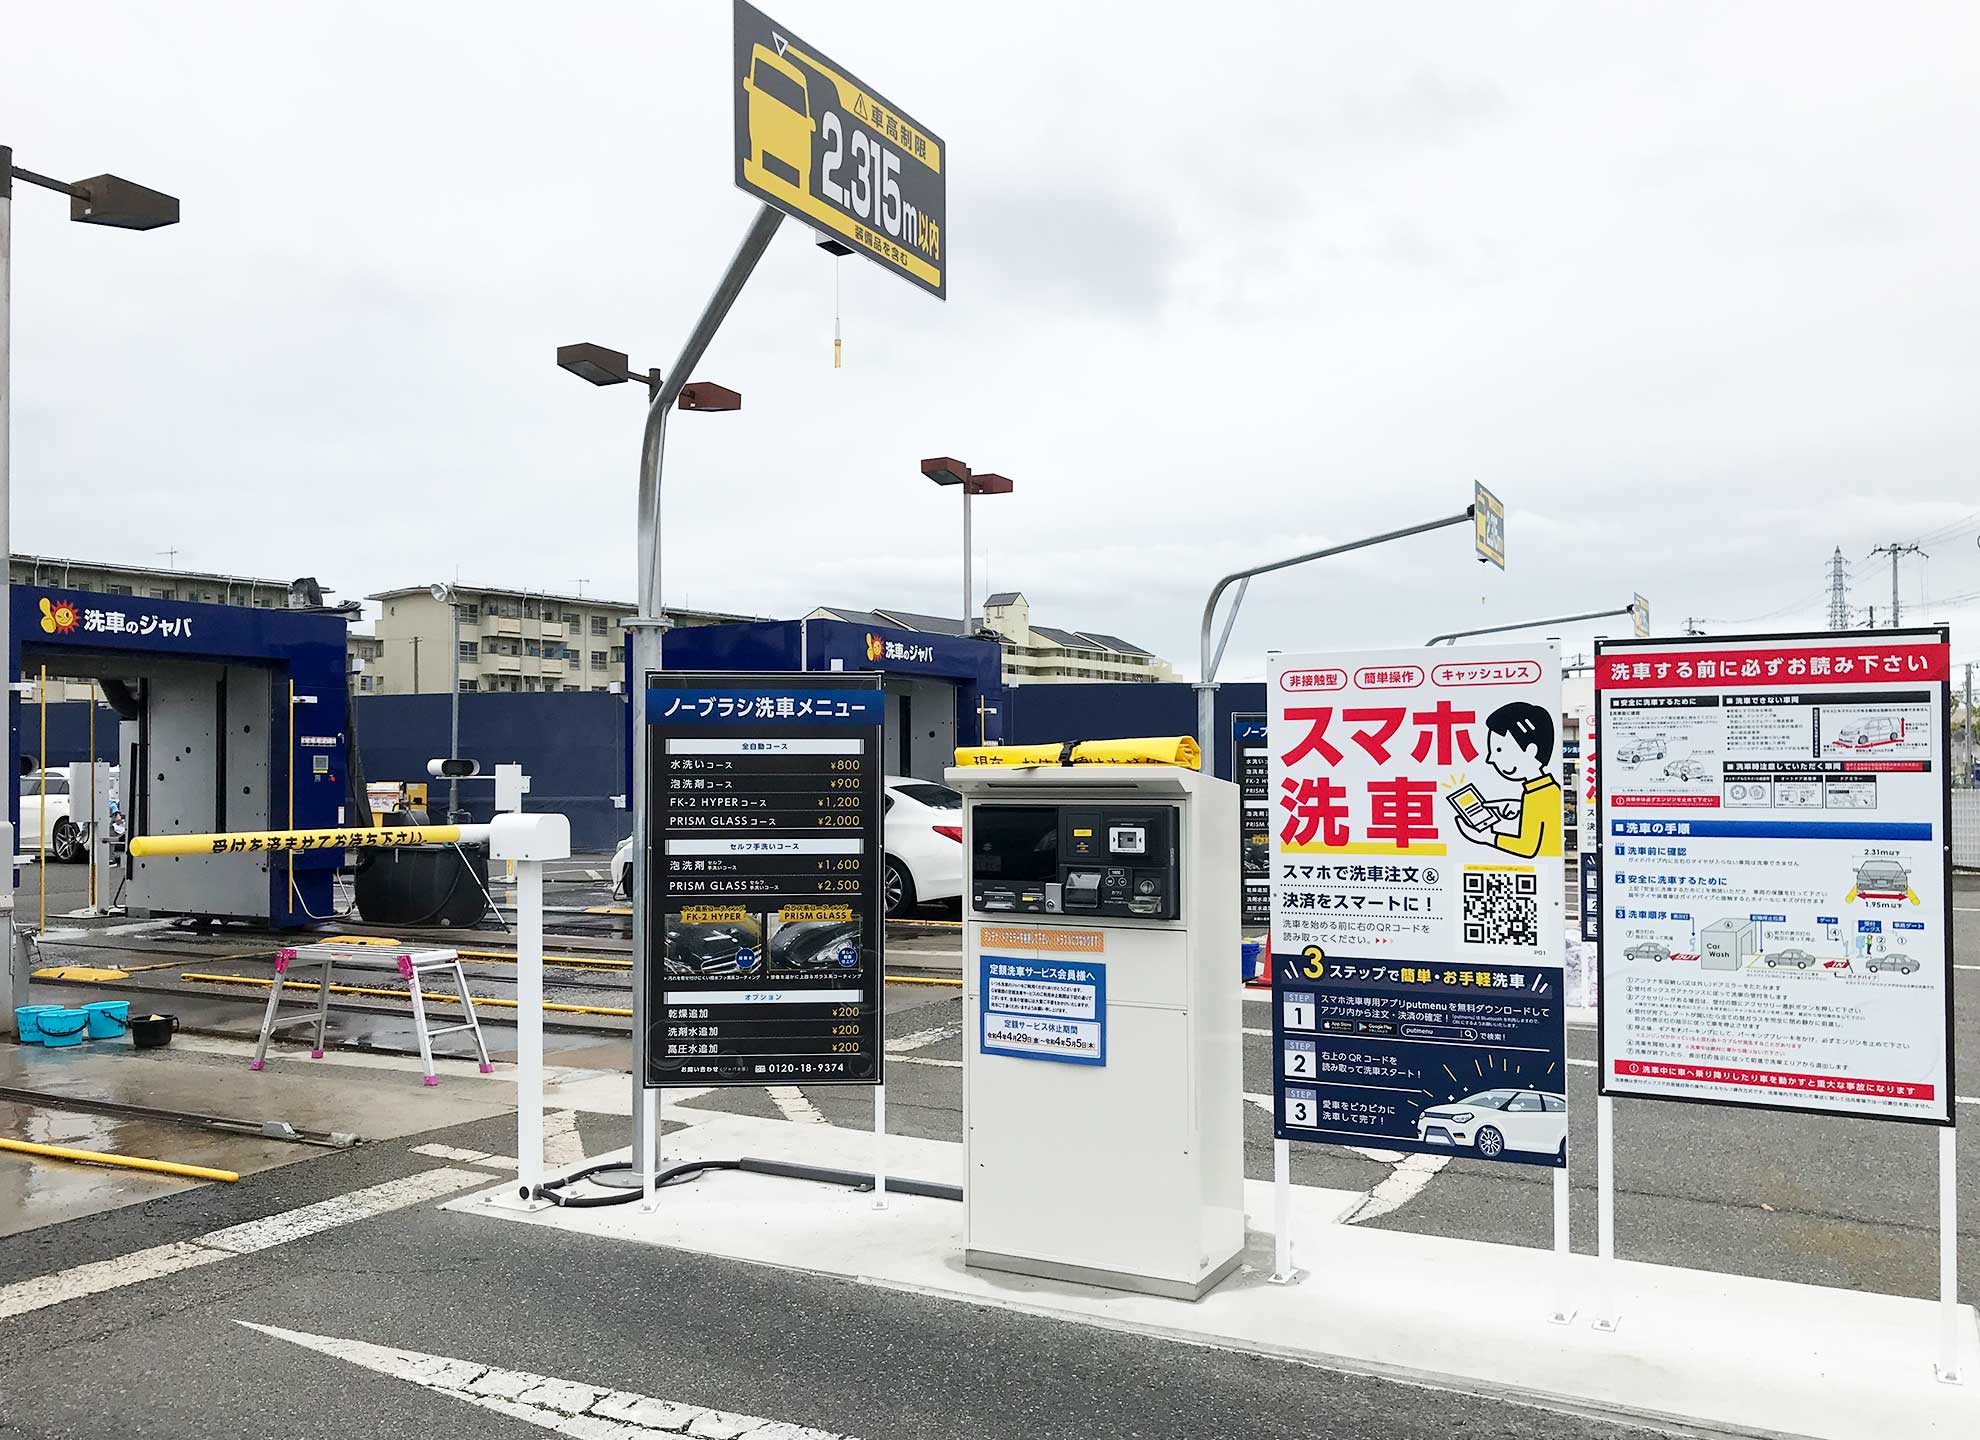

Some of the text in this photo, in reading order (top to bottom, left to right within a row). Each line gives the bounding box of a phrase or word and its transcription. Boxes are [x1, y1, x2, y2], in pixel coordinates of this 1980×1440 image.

[870, 105, 927, 159] 車高制限
[822, 111, 940, 261] 2.315m以内
[854, 225, 908, 266] 装備品を含む
[84, 609, 192, 639] 洗車のジャバ
[886, 641, 933, 662] 洗車のジャバ
[1611, 654, 1928, 681] 洗車する前に必ずお読み下さい
[1290, 666, 1530, 686] 非接触型 簡単操作 キャッシュレス
[664, 697, 866, 718] ノーブラシ洗車メニュー
[1280, 701, 1479, 767] スマホ
[742, 742, 788, 750] 全自動コース
[670, 760, 860, 770] 水洗いコース ¥800
[670, 779, 860, 789] 泡洗剤コース ¥900
[670, 798, 696, 807] FK-2
[818, 797, 860, 808] ¥1,200
[1280, 776, 1439, 848] 洗車
[670, 816, 705, 826] PRISM
[818, 816, 860, 826] ¥2,000
[1626, 823, 1690, 834] 洗車の手順
[1628, 847, 1687, 856] 洗車前に確認
[818, 860, 860, 870] ¥1,600
[1628, 875, 1727, 885] 安全に洗車するために
[669, 881, 704, 891] PRISM
[710, 881, 747, 891] GLASS
[818, 881, 860, 891] ¥2,500
[1628, 911, 1667, 920] 洗車順序
[1282, 920, 1430, 934] 洗車を始める前に右のQRコードを
[1282, 932, 1372, 944] 読み取ってください。
[989, 964, 1095, 981] 定額洗車サービス会員様へ
[1288, 994, 1311, 1002] STEP
[668, 1008, 859, 1018] 乾燥追加 ¥200
[1294, 1007, 1303, 1025] 1
[668, 1025, 859, 1036] 洗剤水追加 ¥200
[1004, 1020, 1078, 1034] 定額サービス休止期間
[1406, 1027, 1433, 1035] putmenu
[668, 1043, 859, 1053] 高圧水追加 ¥200
[1290, 1042, 1311, 1050] STEP
[769, 1063, 844, 1072] 0120-18-9374
[1294, 1055, 1306, 1072] 2
[1642, 1065, 1916, 1096] 洗車中に車へ乗り降りしたり車を動かすと重大な事故になります
[1291, 1090, 1311, 1099] STEP
[1295, 1104, 1306, 1120] 3
[1323, 1100, 1395, 1113] 愛車をピカピカに
